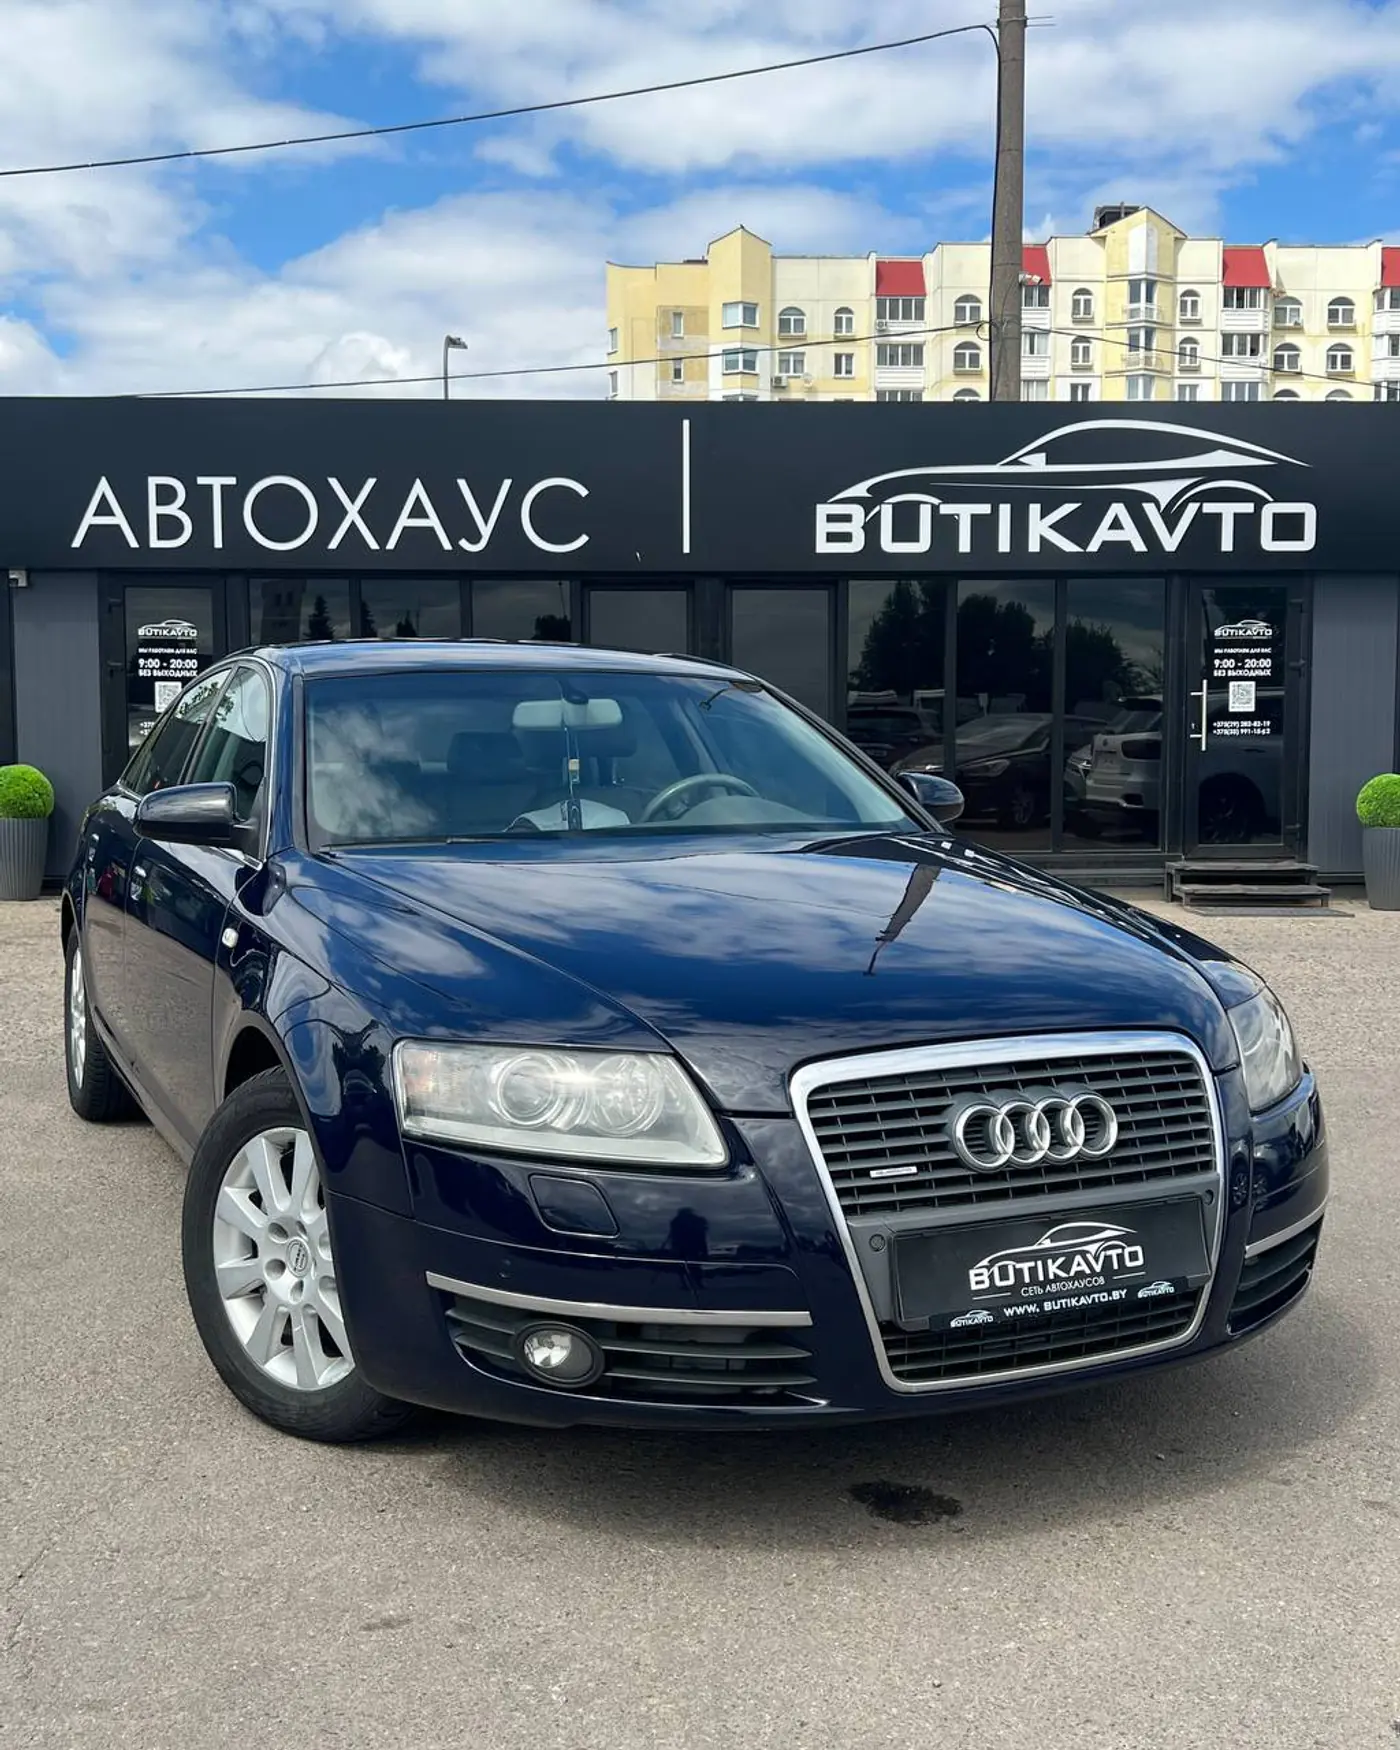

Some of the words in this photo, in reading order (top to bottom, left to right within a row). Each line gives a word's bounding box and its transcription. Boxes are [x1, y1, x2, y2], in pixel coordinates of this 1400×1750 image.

[71, 475, 590, 553] АВТОХАУС
[815, 501, 1317, 552] BUTIKAVTO
[138, 628, 198, 636] BUTIKAVTO
[1214, 628, 1272, 636] BUTIKAVTO
[138, 658, 160, 668] 9:00
[170, 658, 198, 668] 20:00
[1214, 658, 1236, 668] 9:00
[1244, 658, 1272, 668] 20:00
[152, 669, 198, 678] ВЫХОДНЫХ
[1227, 669, 1272, 678] ВЫХОДНЫХ
[968, 1245, 1144, 1290] BUTIKAVTO
[1020, 1285, 1044, 1297] СЕТЬ
[1045, 1275, 1105, 1293] АВТОХАУСОВ
[1003, 1302, 1040, 1317] WWW.
[1044, 1289, 1128, 1311] BUTIKAVTO.BY
